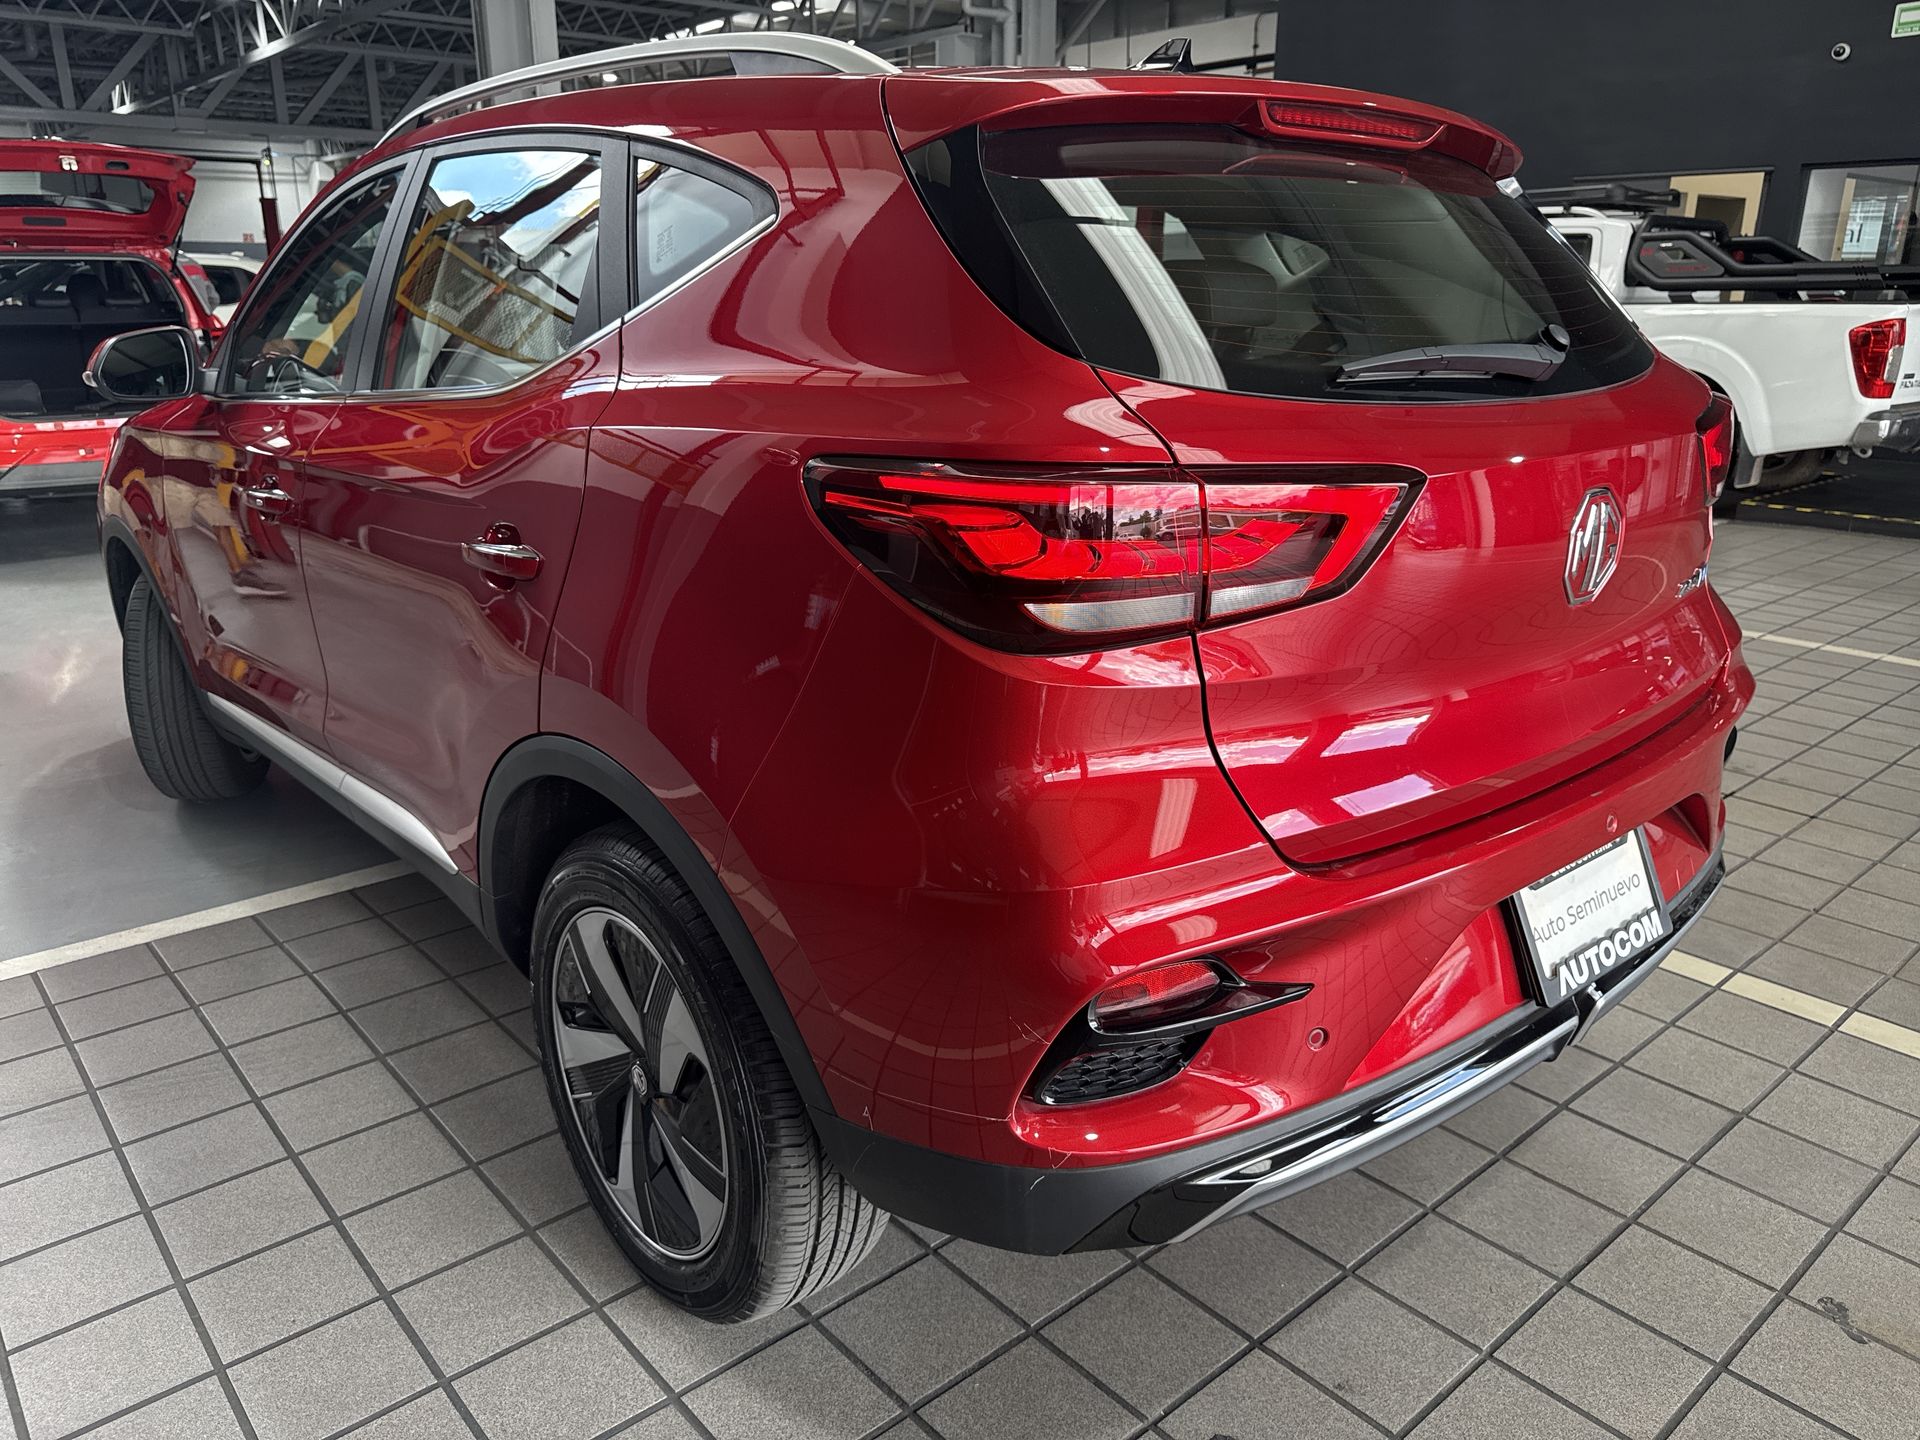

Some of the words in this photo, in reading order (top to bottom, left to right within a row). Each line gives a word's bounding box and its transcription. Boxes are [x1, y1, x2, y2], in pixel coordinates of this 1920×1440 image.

[1569, 498, 1618, 597] MG
[1532, 914, 1566, 944] Auto
[1568, 872, 1641, 926] Seminuevo
[1560, 909, 1664, 997] AUTOCOM
